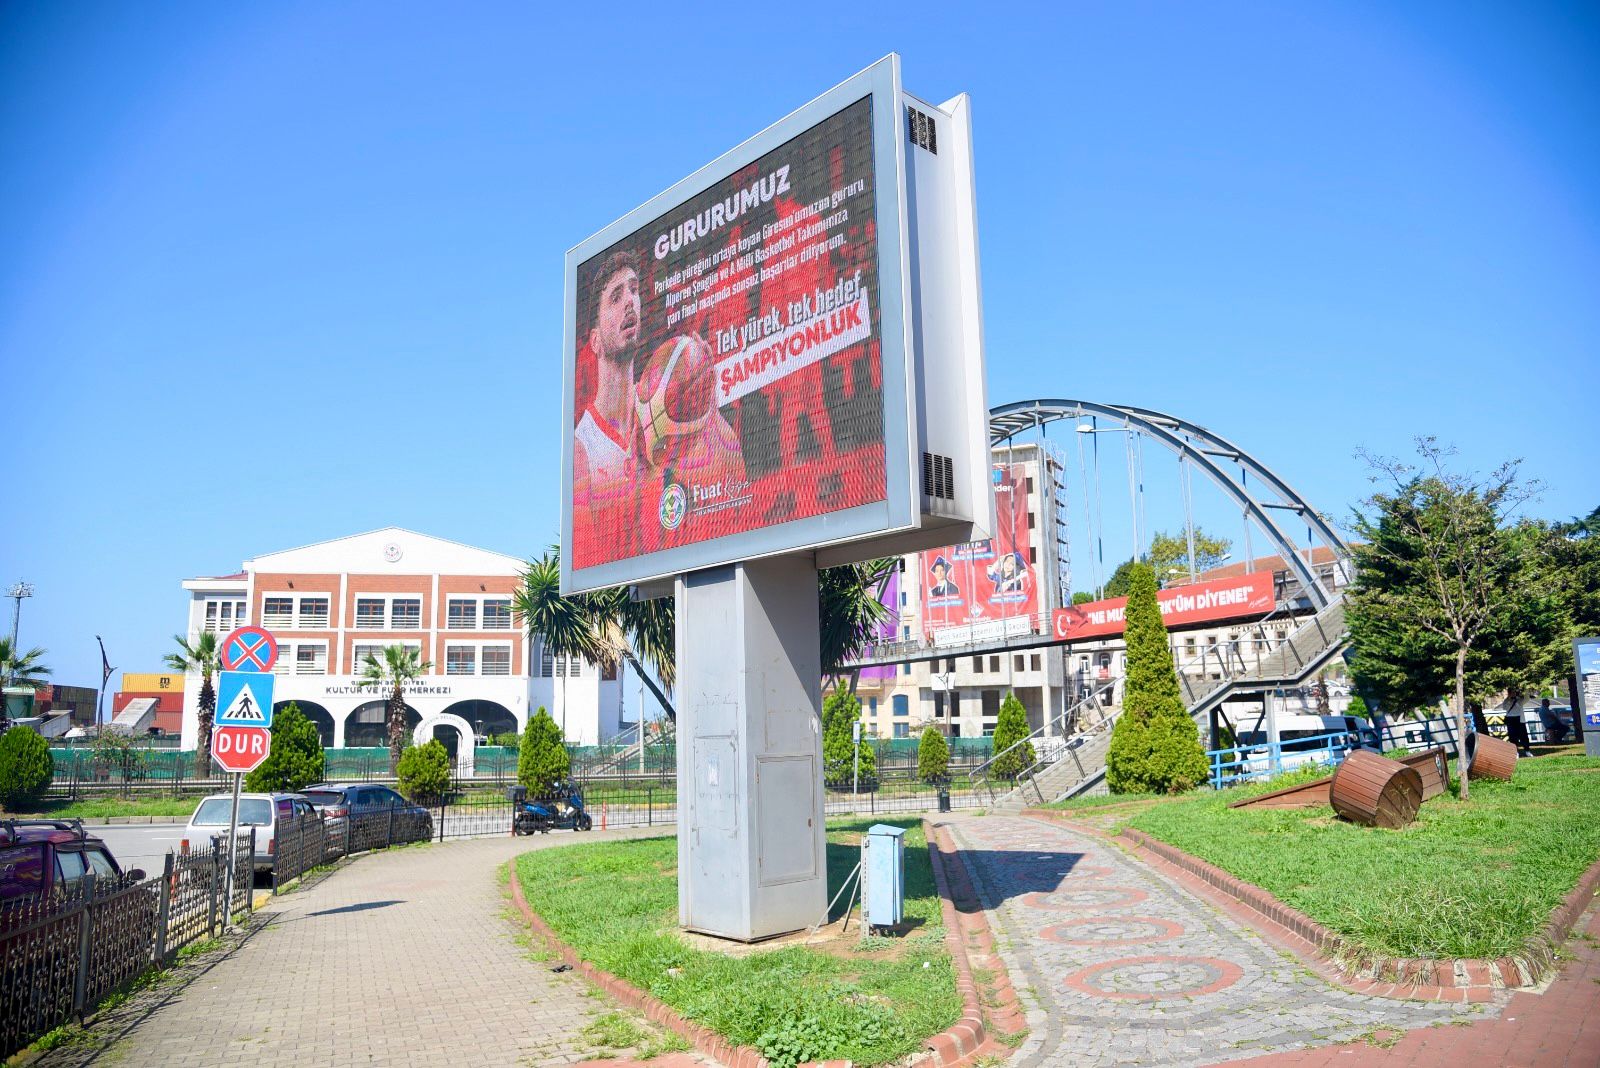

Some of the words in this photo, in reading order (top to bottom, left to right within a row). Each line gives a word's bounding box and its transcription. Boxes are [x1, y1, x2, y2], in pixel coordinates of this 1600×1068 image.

[654, 164, 791, 260] GURURUMUZ
[654, 271, 682, 295] Parkede
[682, 254, 711, 284] yüreğini
[713, 244, 737, 265] ortaya
[738, 231, 761, 252] koyan
[832, 179, 864, 209] gururu
[666, 286, 692, 308] Alperen
[693, 272, 719, 297] Şengün
[719, 267, 729, 280] ve
[736, 251, 754, 272] Milli
[755, 231, 796, 263] Basketbol
[797, 209, 848, 243] Takımımıza
[667, 313, 681, 329] yarı
[682, 300, 698, 319] final
[699, 285, 731, 310] maçında
[731, 272, 759, 295] sonsuz
[760, 253, 799, 282] başarılar
[801, 232, 847, 263] diliyorum.
[716, 325, 739, 354] Tek
[740, 307, 785, 352] yürek,
[788, 293, 812, 326] tek
[693, 480, 722, 502] Fuat
[366, 686, 379, 694] VE
[218, 733, 263, 754] DUR
